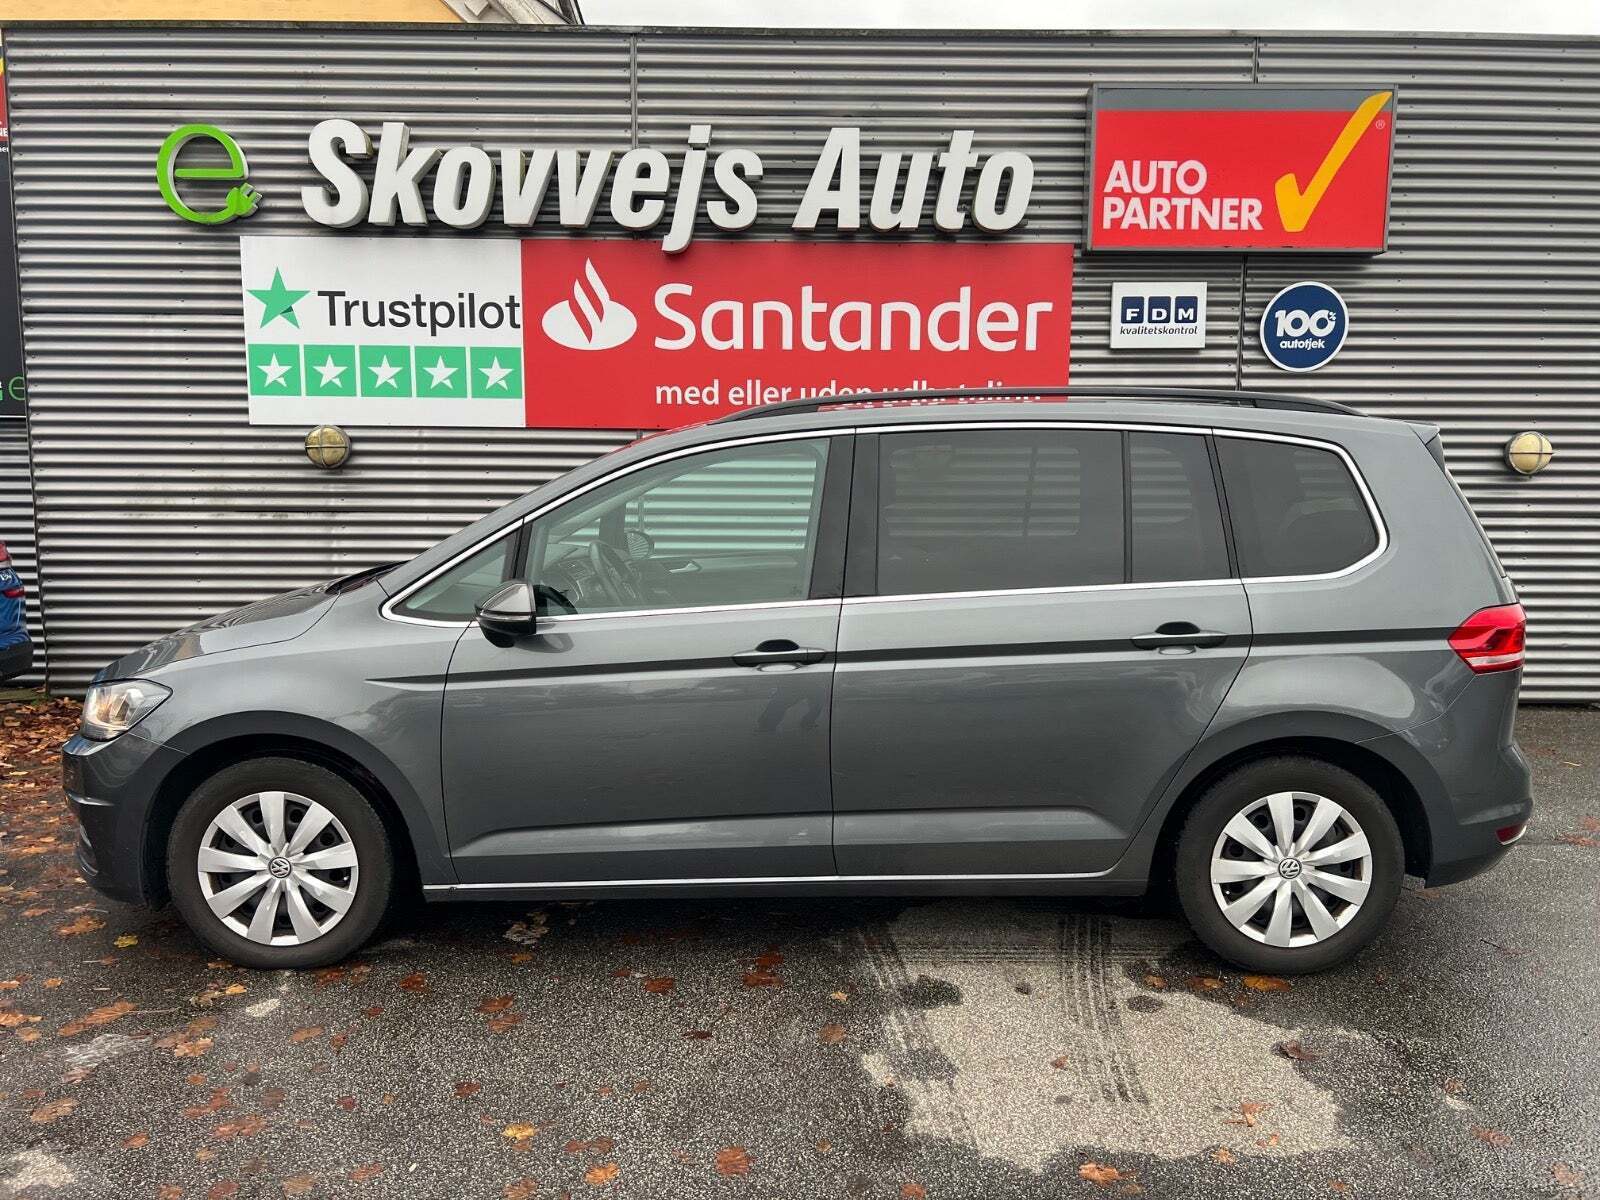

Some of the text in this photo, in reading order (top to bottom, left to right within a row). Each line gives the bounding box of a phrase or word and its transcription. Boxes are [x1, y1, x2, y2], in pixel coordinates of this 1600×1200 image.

[301, 118, 1035, 254] Skovvejs Auto
[1103, 159, 1208, 195] AUTO
[1102, 197, 1264, 231] PARTNER
[317, 290, 521, 337] Trustpilot
[653, 283, 1053, 351] Santander
[1120, 325, 1198, 335] kvalitetskontrol
[1125, 307, 1195, 321] FDM
[655, 379, 720, 405] med
[728, 379, 792, 406] eller
